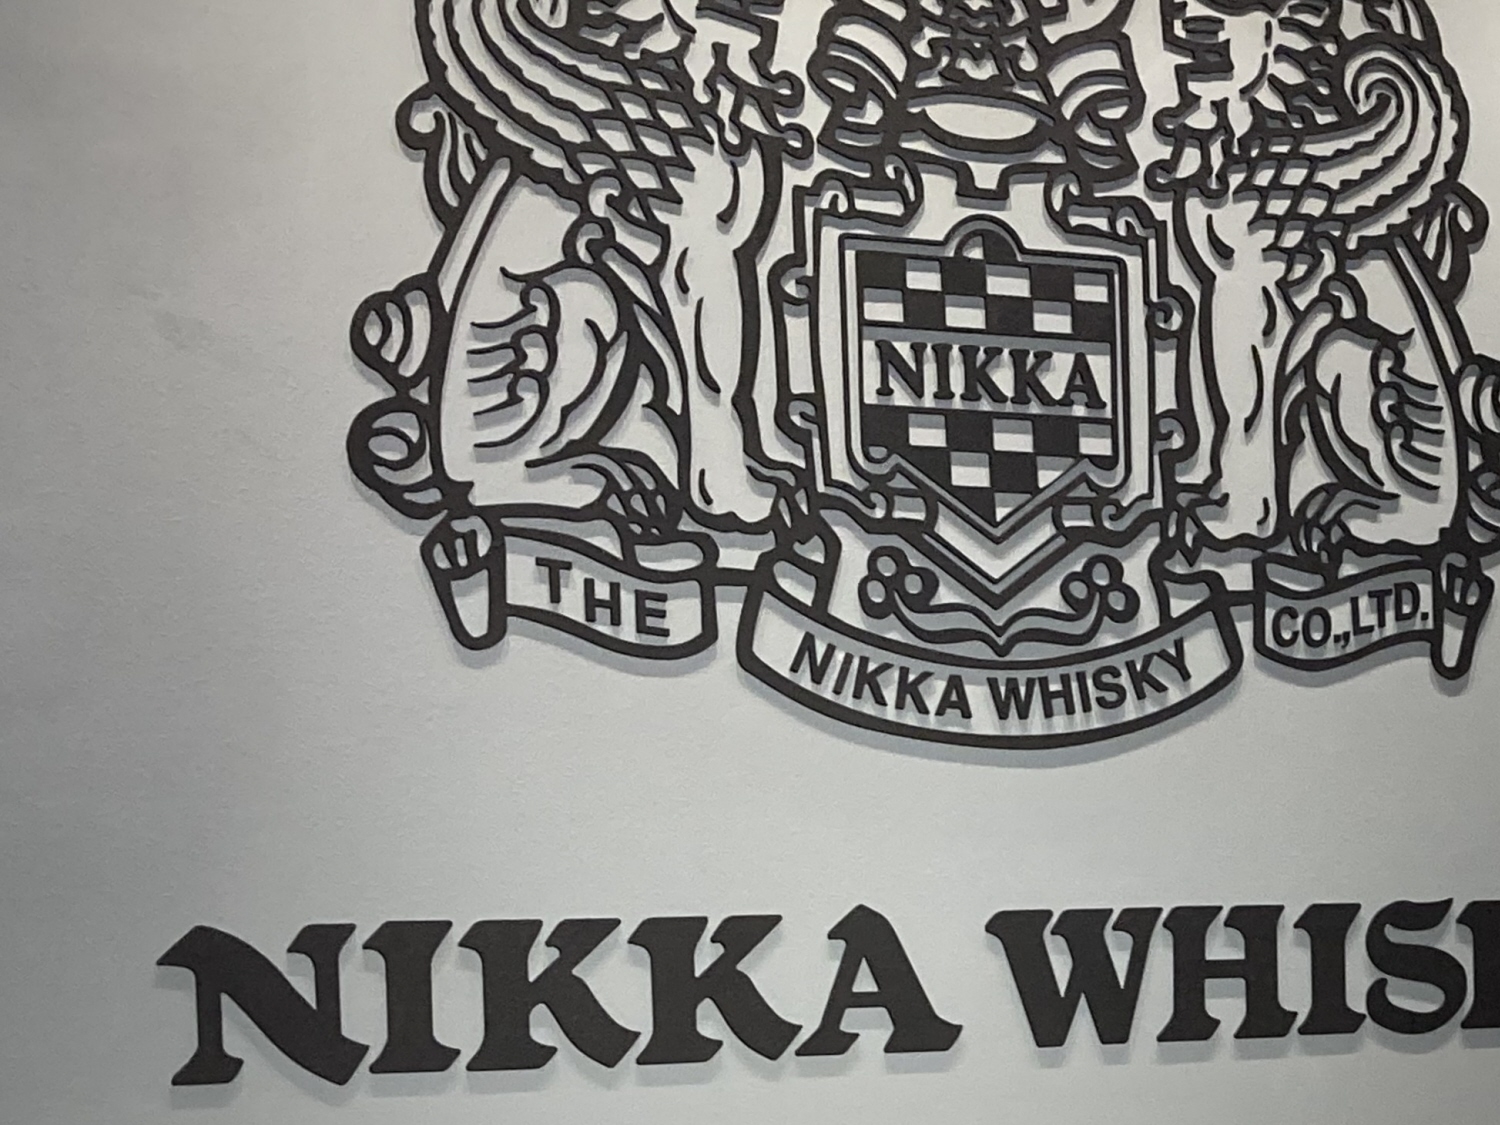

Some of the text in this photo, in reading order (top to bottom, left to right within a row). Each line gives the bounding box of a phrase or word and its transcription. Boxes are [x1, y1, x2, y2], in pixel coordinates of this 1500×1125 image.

[875, 338, 1107, 409] NIKKA
[535, 556, 670, 638] THE
[790, 631, 1192, 721] NIKKA WHISKY
[156, 904, 963, 1086] NIKKA
